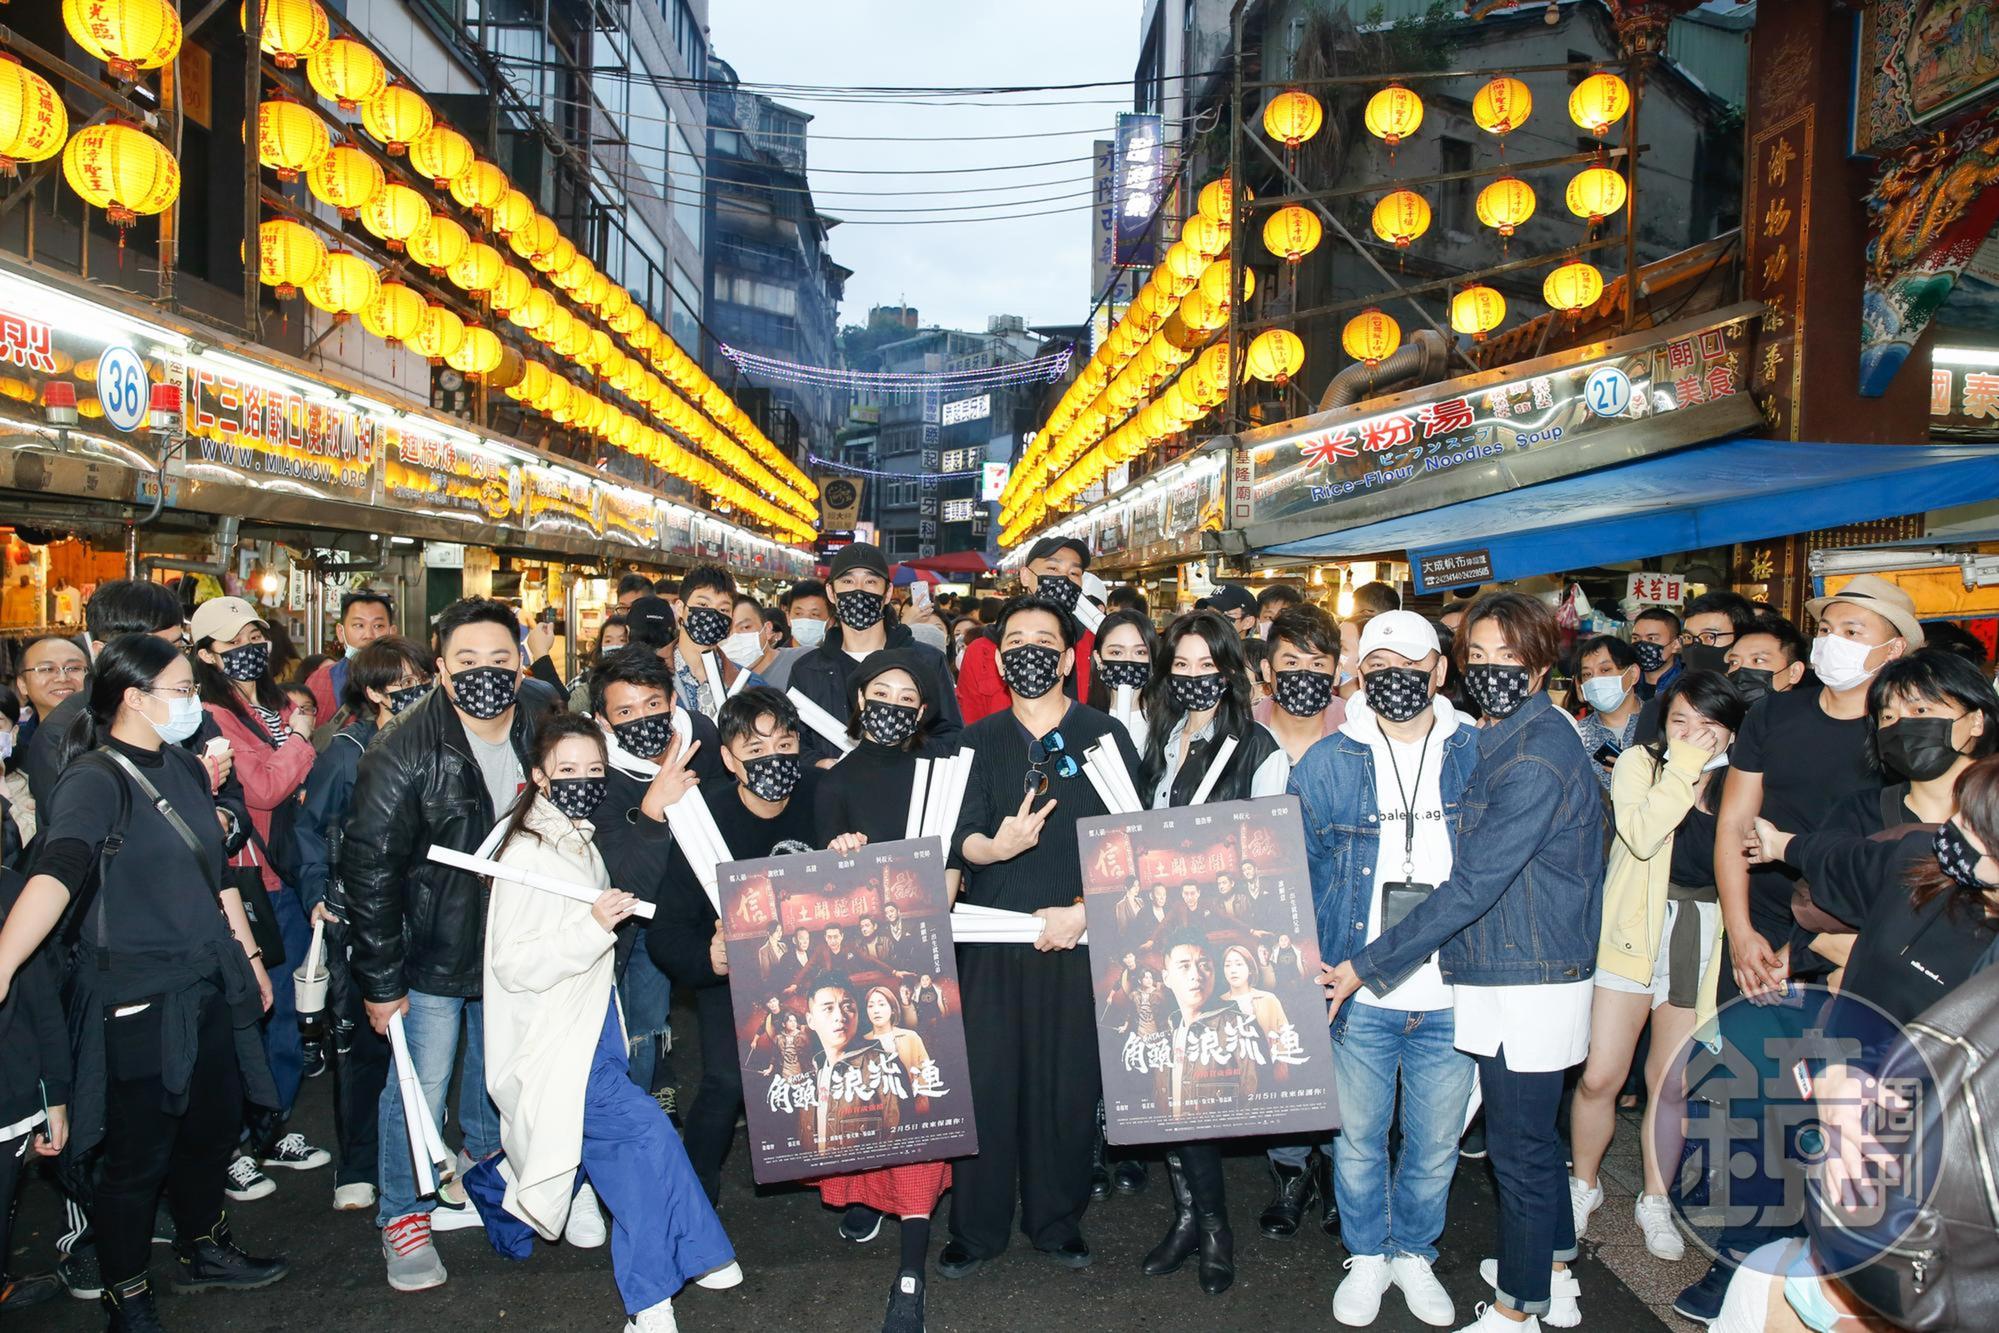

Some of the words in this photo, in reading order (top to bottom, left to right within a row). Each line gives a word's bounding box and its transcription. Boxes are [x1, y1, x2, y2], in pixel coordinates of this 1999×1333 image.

[83, 137, 109, 192] 開漳聖王
[1668, 329, 1726, 369] 廟口
[109, 360, 138, 417] 36
[1593, 375, 1618, 410] 27
[1674, 365, 1736, 409] 美食
[1302, 397, 1474, 468] 米粉湯
[1235, 450, 1250, 518] 基隆廟口
[1311, 464, 1414, 501] Rice-Flour
[1425, 441, 1504, 471] Noodles
[1515, 425, 1564, 448] Soup
[1422, 556, 1466, 574] 大成帆布
[1632, 579, 1680, 602] 米苔目
[736, 887, 767, 922] 信
[1122, 1031, 1175, 1074] 角頭
[1186, 1015, 1311, 1066] 浪流連
[766, 1073, 819, 1113] 角頭
[831, 1051, 951, 1103] 浪流連
[890, 1122, 919, 1134] 2月5日
